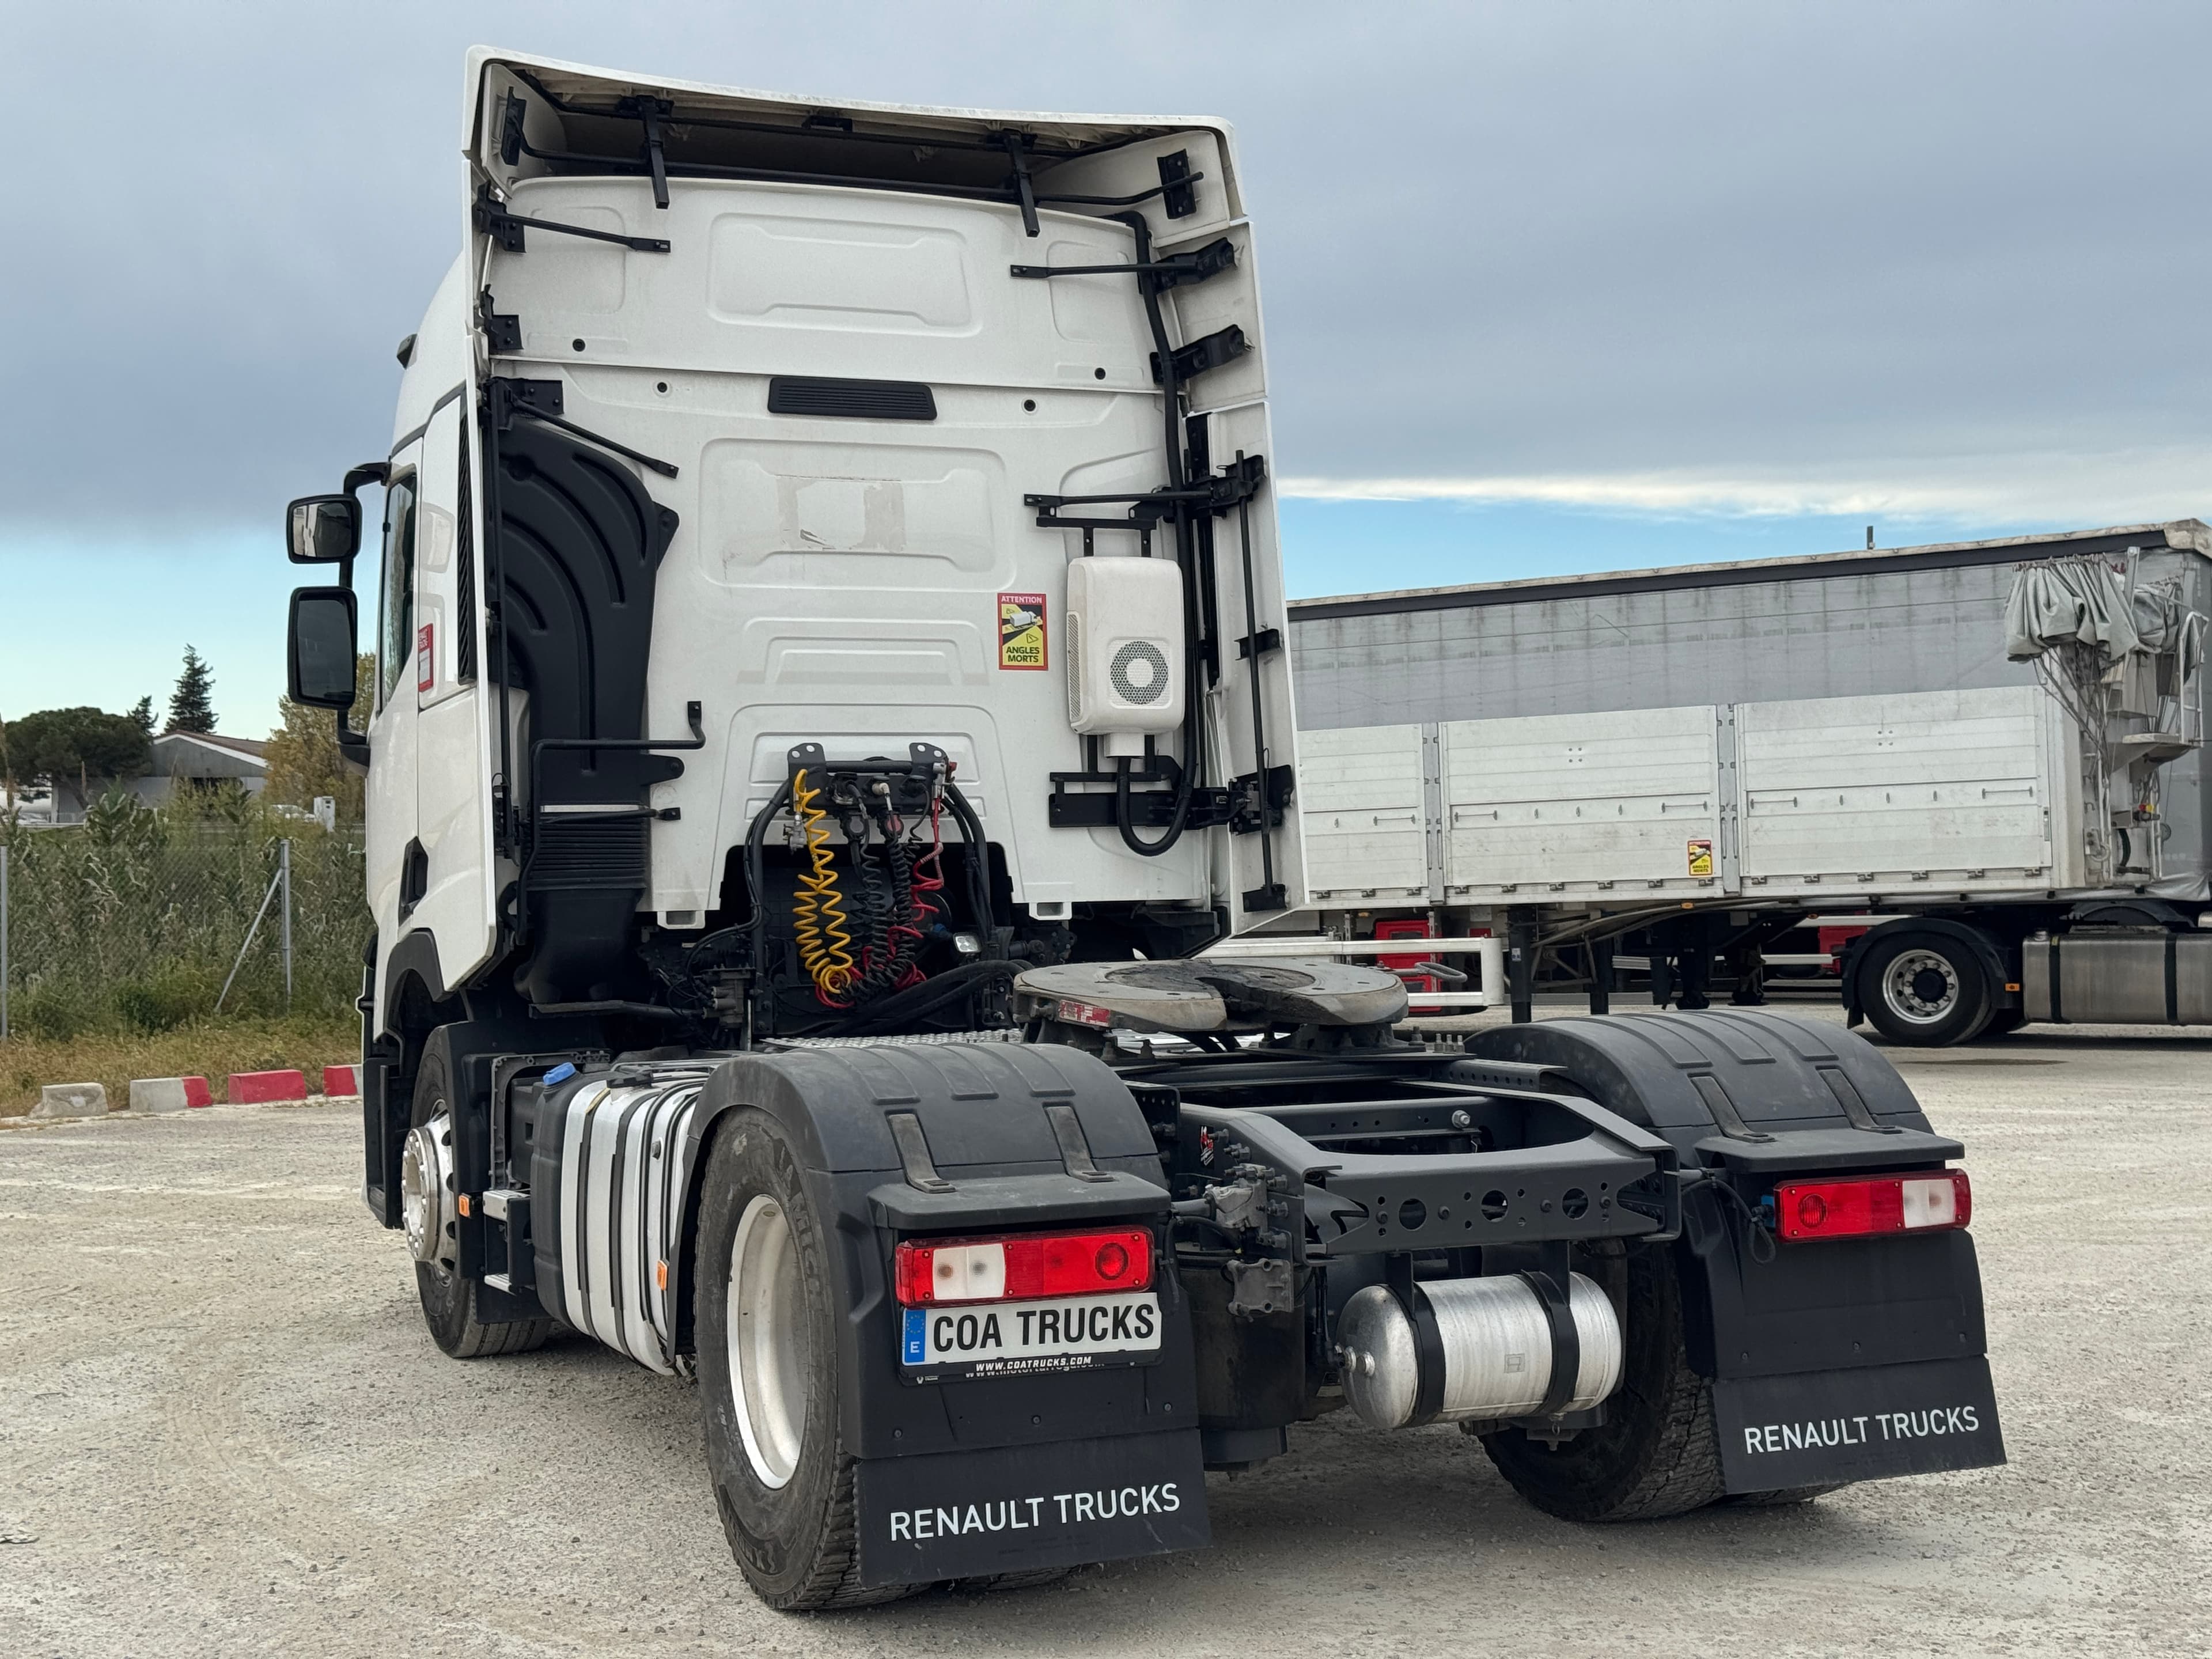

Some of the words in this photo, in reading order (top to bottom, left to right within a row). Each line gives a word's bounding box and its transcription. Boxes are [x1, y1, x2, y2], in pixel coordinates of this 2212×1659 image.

[1001, 596, 1042, 604] ATTENTION
[1006, 646, 1040, 654] ANGLES
[1008, 654, 1039, 662] MORTS
[933, 1313, 1003, 1352] COA
[1016, 1304, 1154, 1346] TRUCKS
[910, 1341, 920, 1354] E
[976, 1356, 1092, 1372] WWW.COATRUCKS.COM
[1744, 1416, 1868, 1455] RENAULT
[1876, 1406, 1979, 1440] TRUCKS
[889, 1497, 1044, 1541] RENAULT
[1053, 1483, 1180, 1524] TRUCKS
